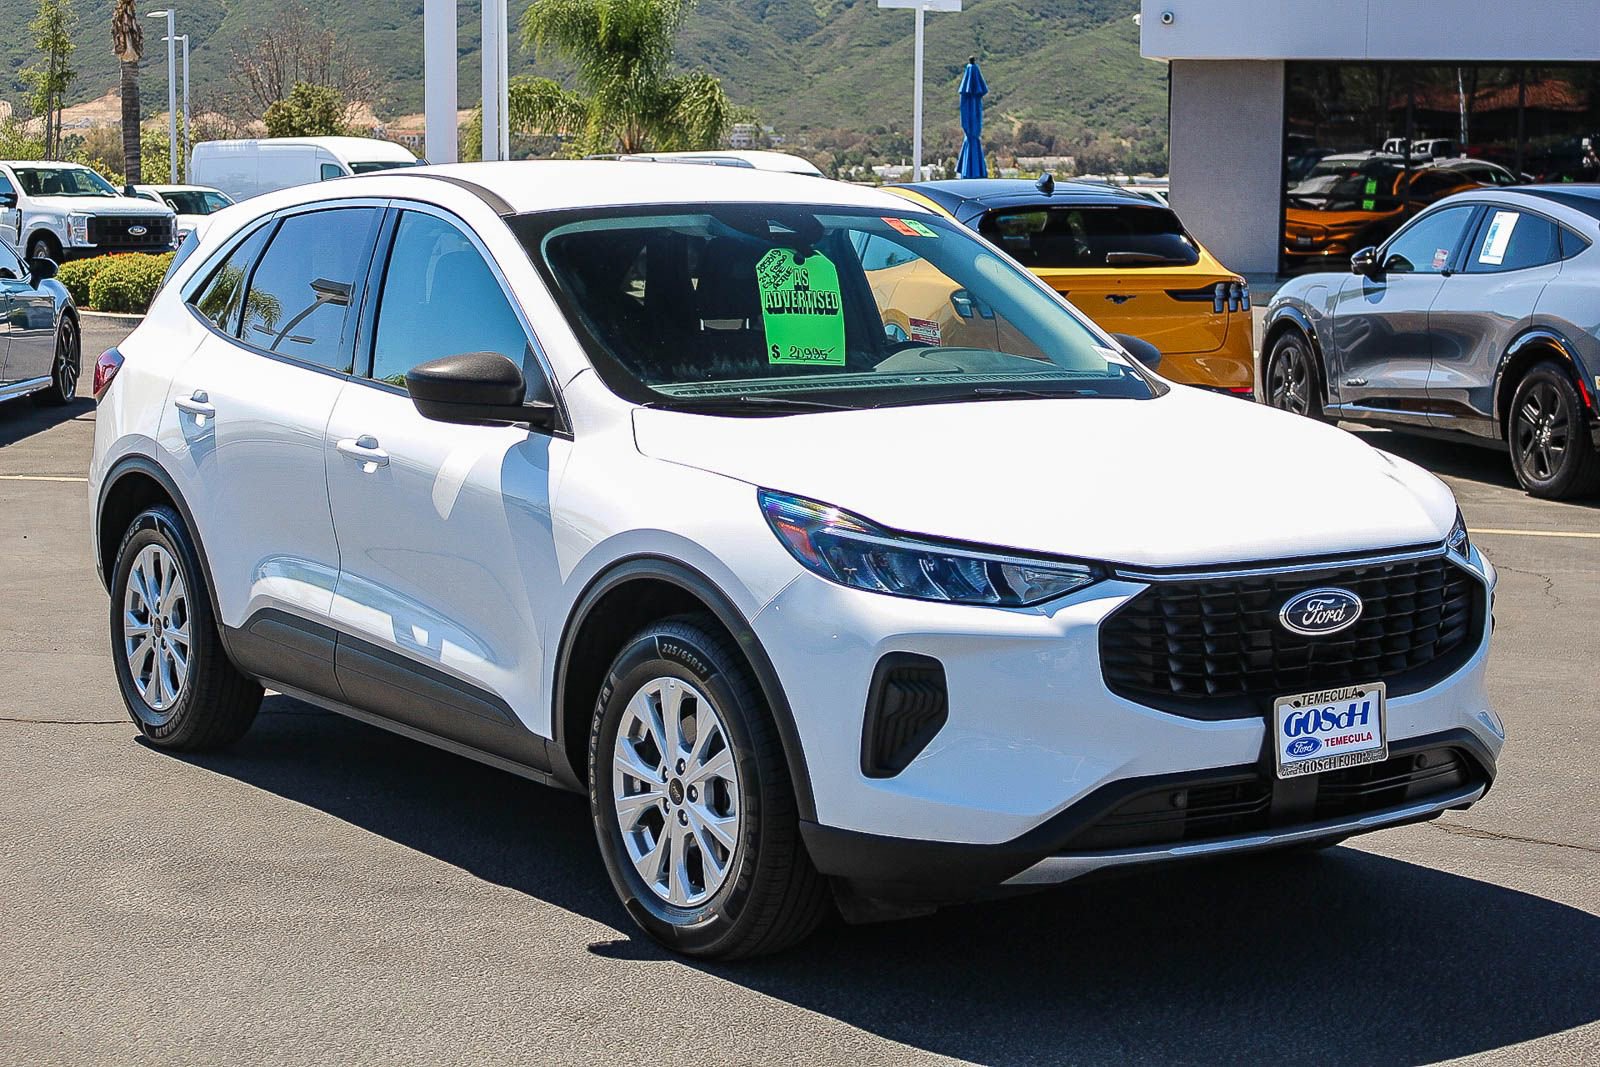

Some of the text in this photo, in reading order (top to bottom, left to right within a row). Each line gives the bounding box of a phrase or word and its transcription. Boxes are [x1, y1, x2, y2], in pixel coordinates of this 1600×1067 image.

[793, 268, 810, 291] AS
[765, 290, 839, 315] ADVERTISED
[1302, 599, 1346, 625] Ford
[1301, 687, 1358, 706] TEMECULA
[1324, 731, 1373, 747] TEMECULA
[1339, 752, 1363, 767] FORD
